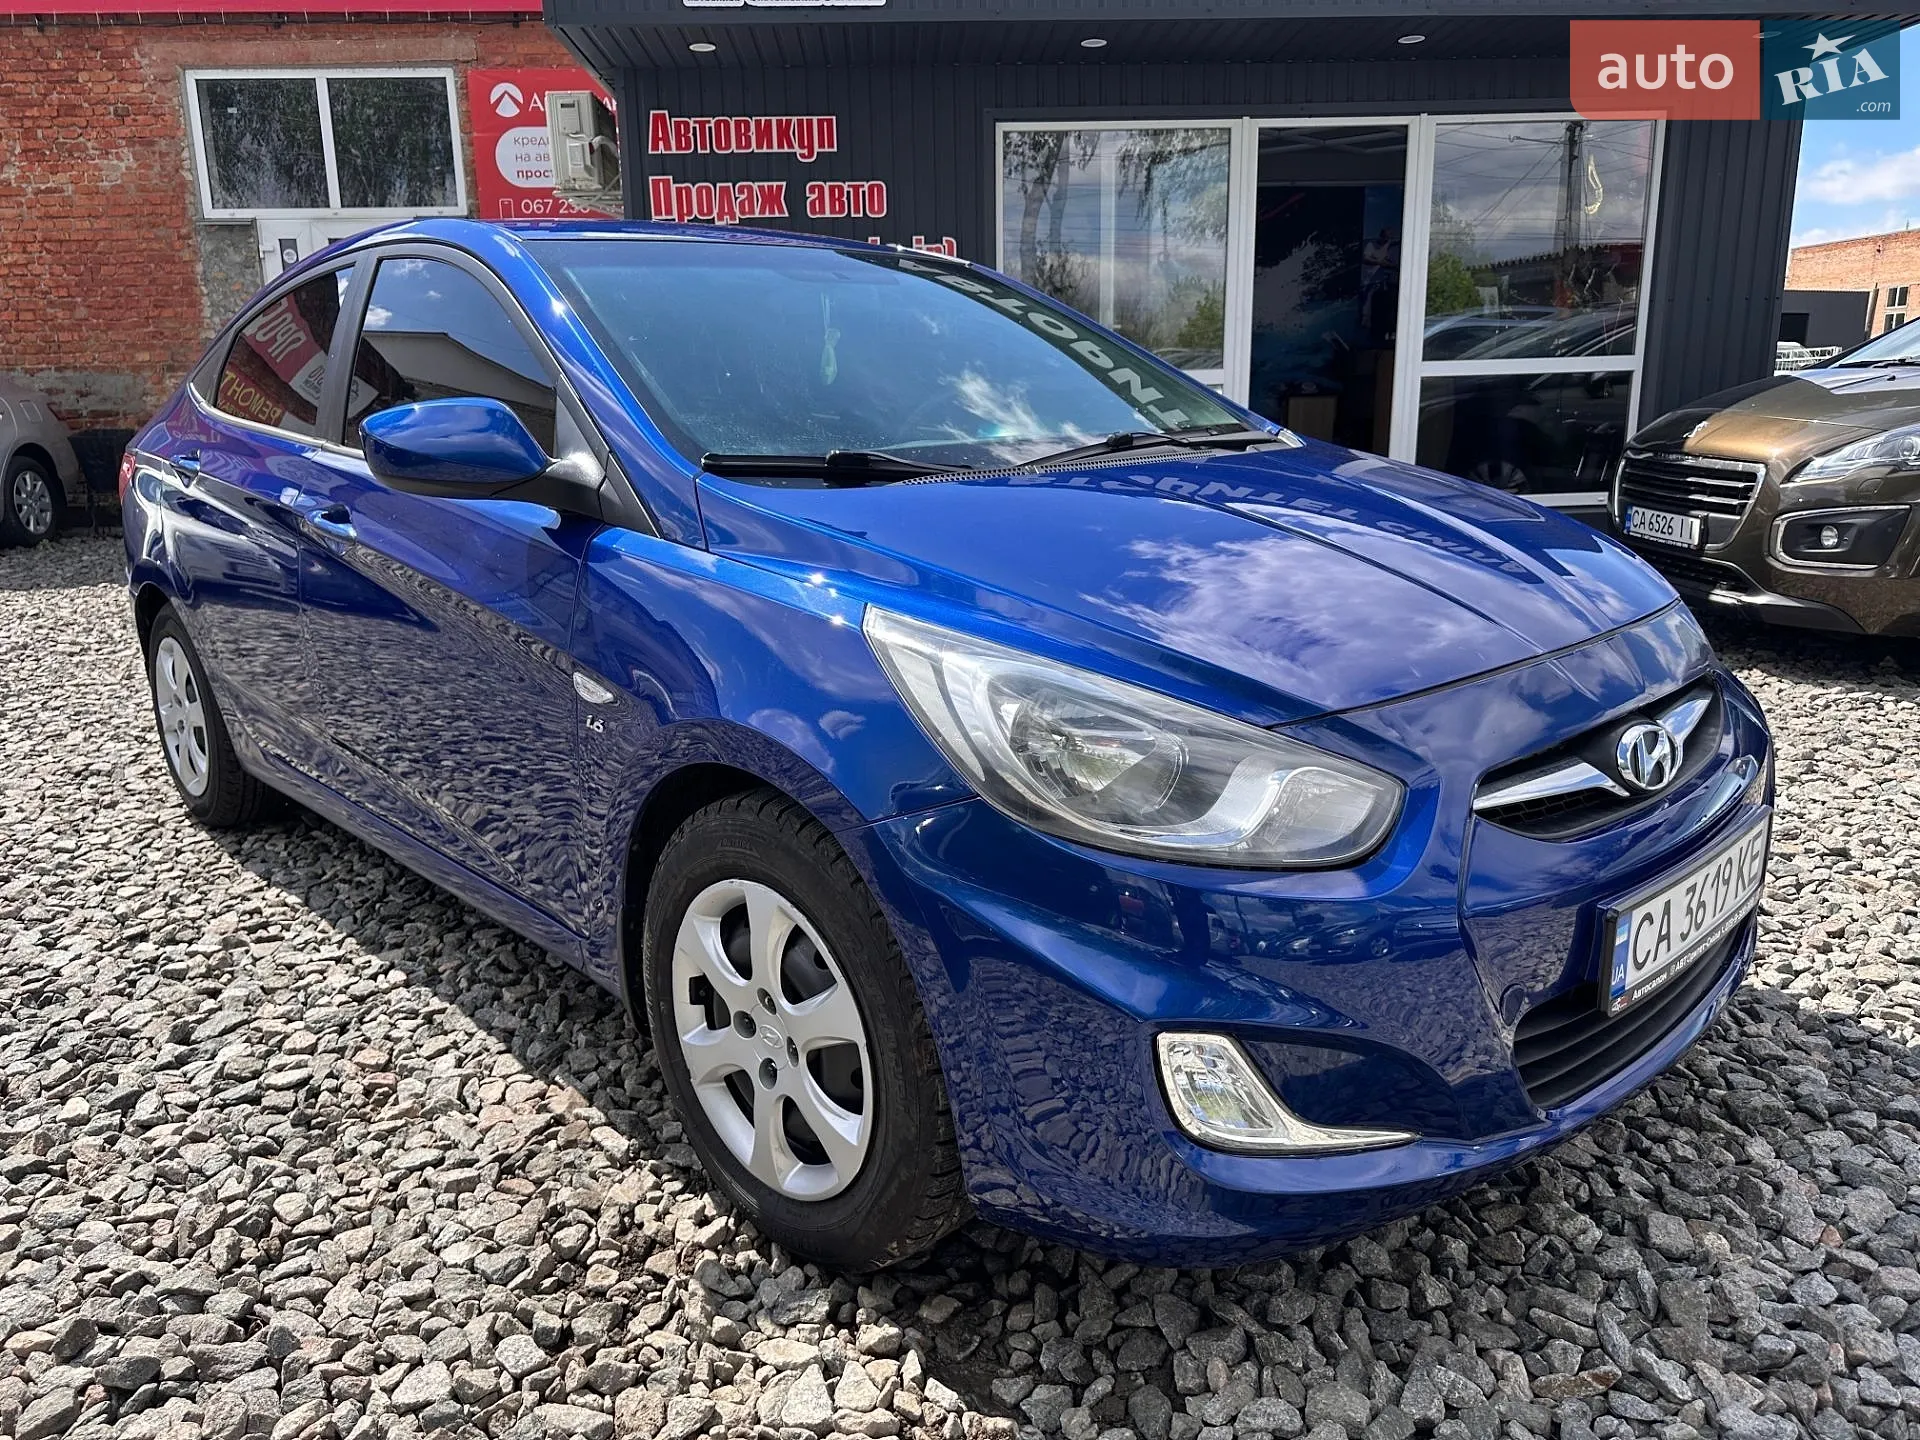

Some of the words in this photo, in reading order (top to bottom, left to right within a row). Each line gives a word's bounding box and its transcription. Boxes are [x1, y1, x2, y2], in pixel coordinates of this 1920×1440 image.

[648, 110, 837, 163] Автовикуп
[515, 153, 531, 163] на
[521, 199, 553, 215] 067
[648, 175, 789, 224] Продаж
[805, 180, 887, 218] авто
[1631, 509, 1646, 531] CA
[1648, 512, 1674, 536] 6526
[1632, 898, 1672, 972] CA
[1679, 856, 1733, 943] 3619
[1734, 828, 1764, 901] KE
